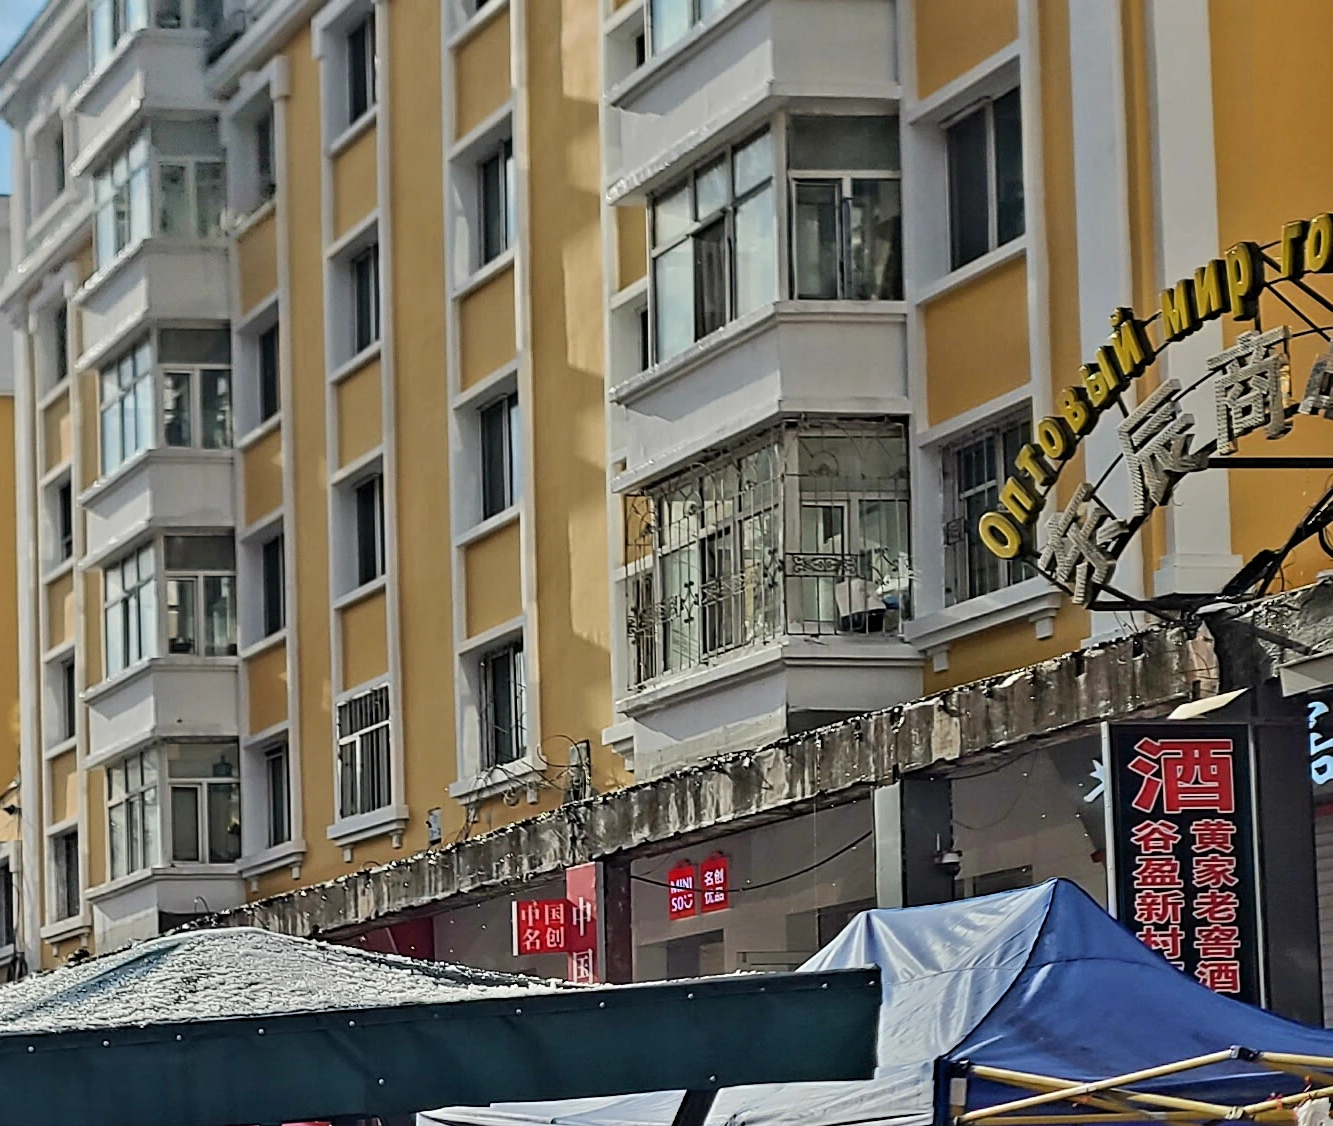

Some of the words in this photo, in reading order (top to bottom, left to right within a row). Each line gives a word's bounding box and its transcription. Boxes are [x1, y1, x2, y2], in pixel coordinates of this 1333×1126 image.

[1159, 242, 1259, 341] мир
[1037, 326, 1333, 604] 东辰商
[1128, 737, 1235, 814] 酒
[521, 901, 564, 926] 中国
[670, 877, 693, 894] MINI
[704, 868, 724, 886] 名创
[1131, 820, 1185, 972] 谷盈新村
[1190, 819, 1242, 993] 黄家老窖酒
[522, 926, 564, 951] 名创
